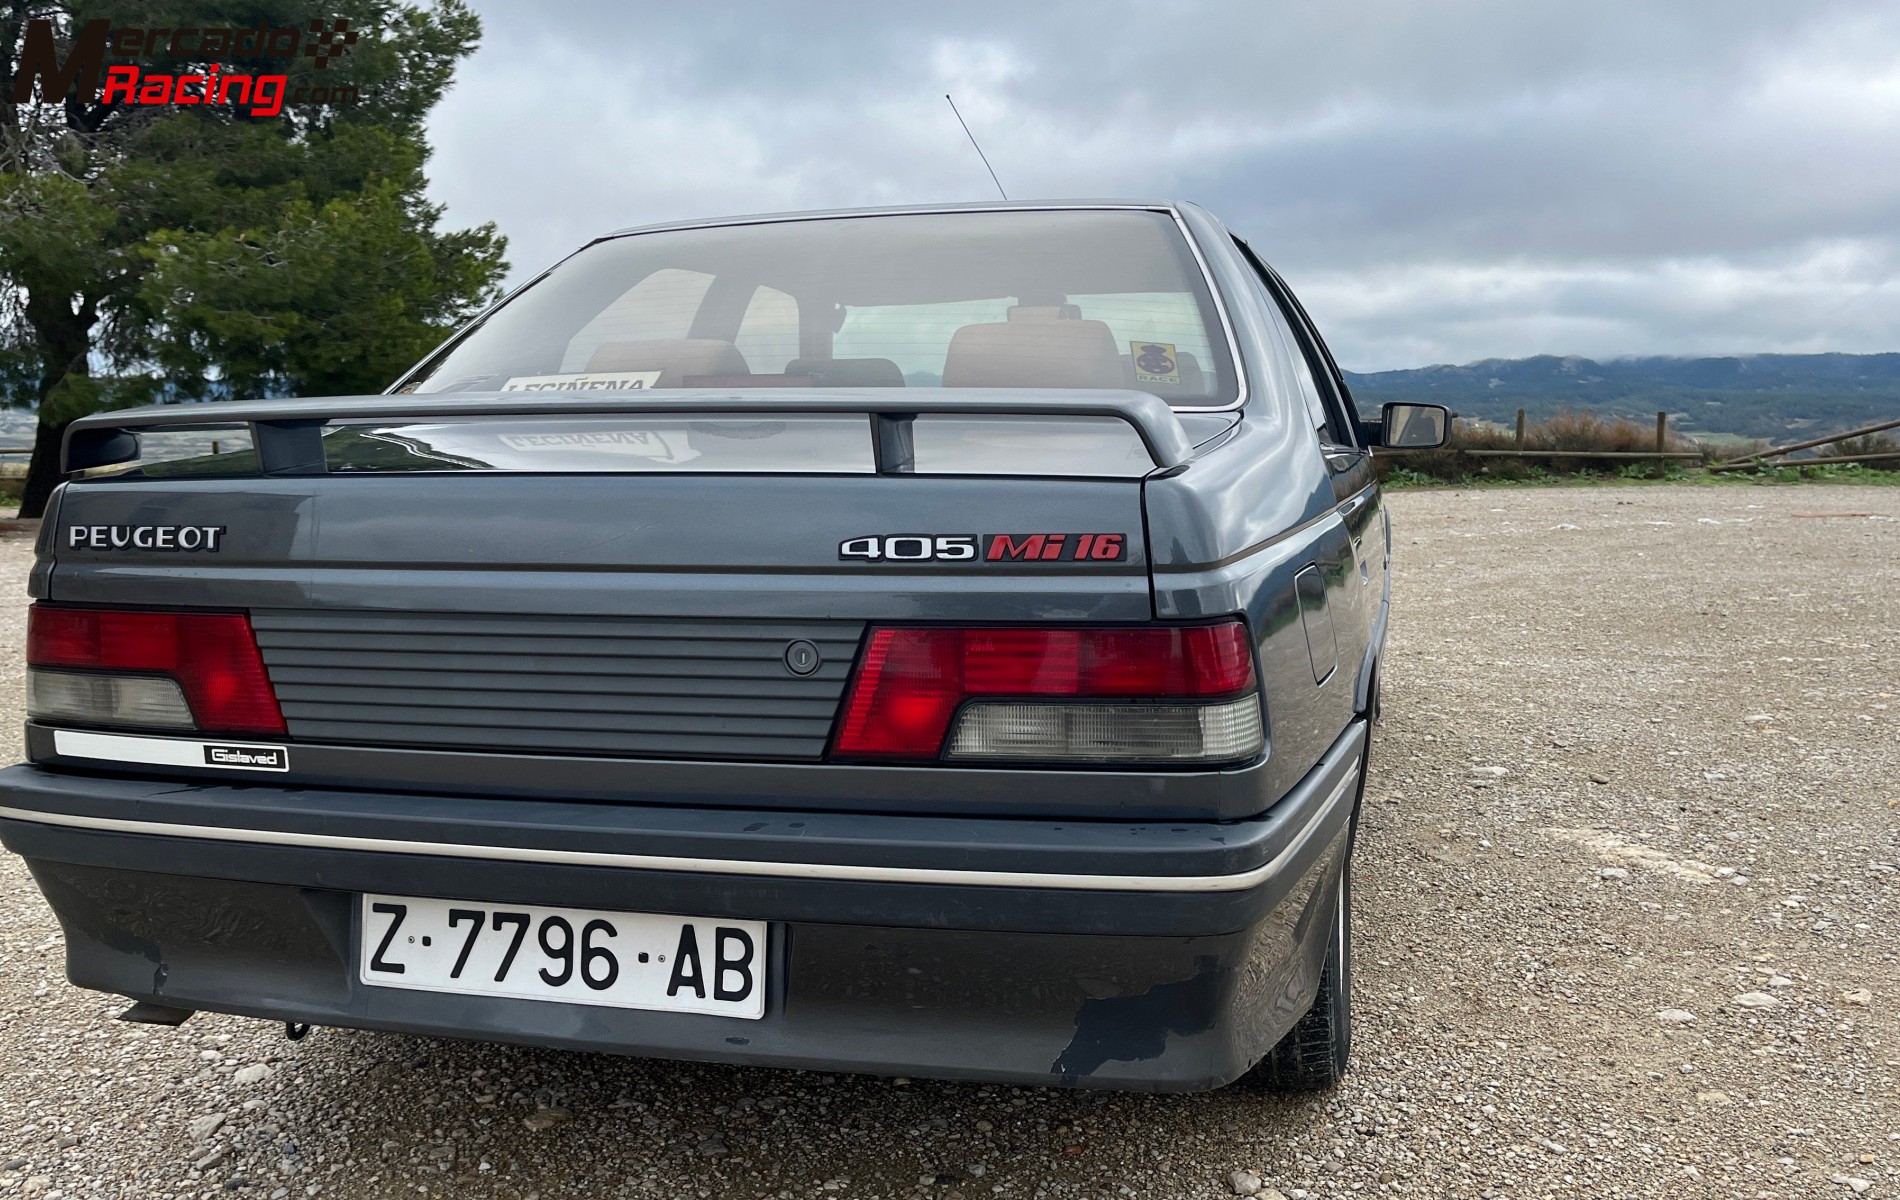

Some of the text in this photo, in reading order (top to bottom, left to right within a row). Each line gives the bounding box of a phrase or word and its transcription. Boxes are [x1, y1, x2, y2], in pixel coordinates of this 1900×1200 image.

[69, 526, 220, 549] PEUGEOT
[841, 536, 975, 560] 405
[211, 748, 278, 765] Gislaved
